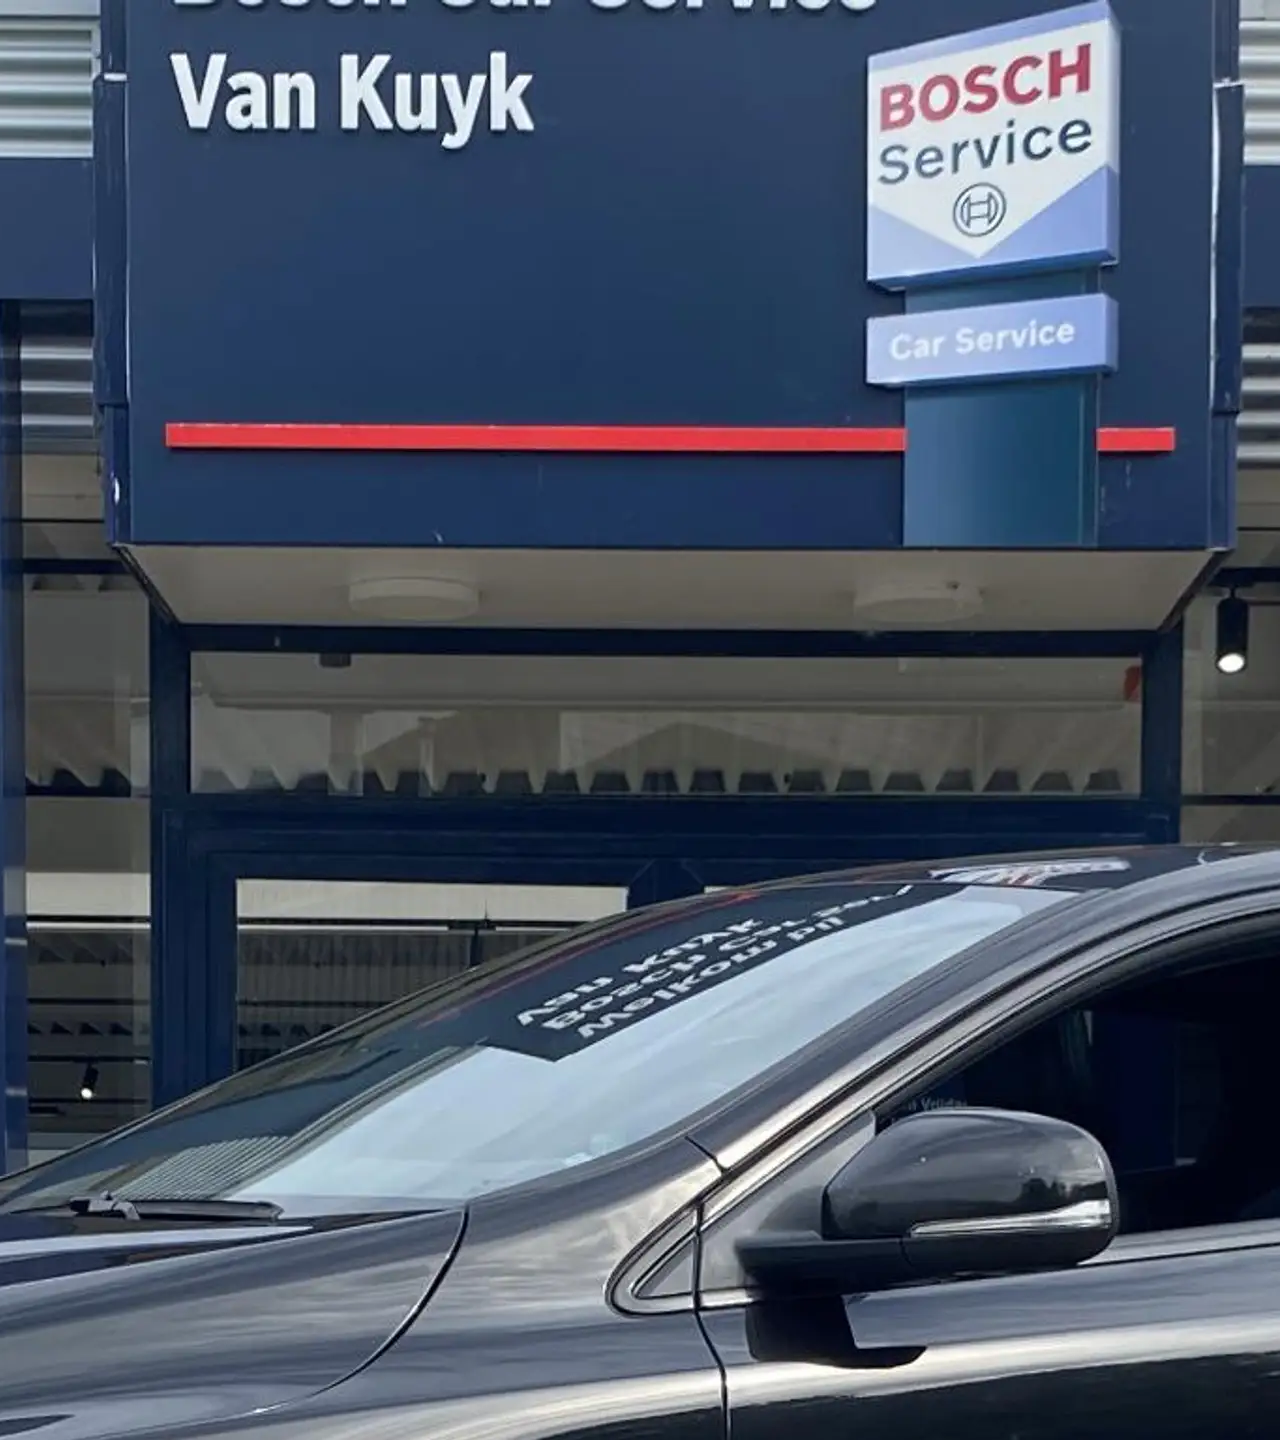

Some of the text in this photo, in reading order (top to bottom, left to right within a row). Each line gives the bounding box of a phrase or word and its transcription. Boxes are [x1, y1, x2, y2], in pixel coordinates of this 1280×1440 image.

[169, 51, 535, 149] Van Kuyk
[879, 43, 1092, 132] BOSCH
[878, 118, 1093, 185] Service
[889, 319, 1077, 361] Car Service
